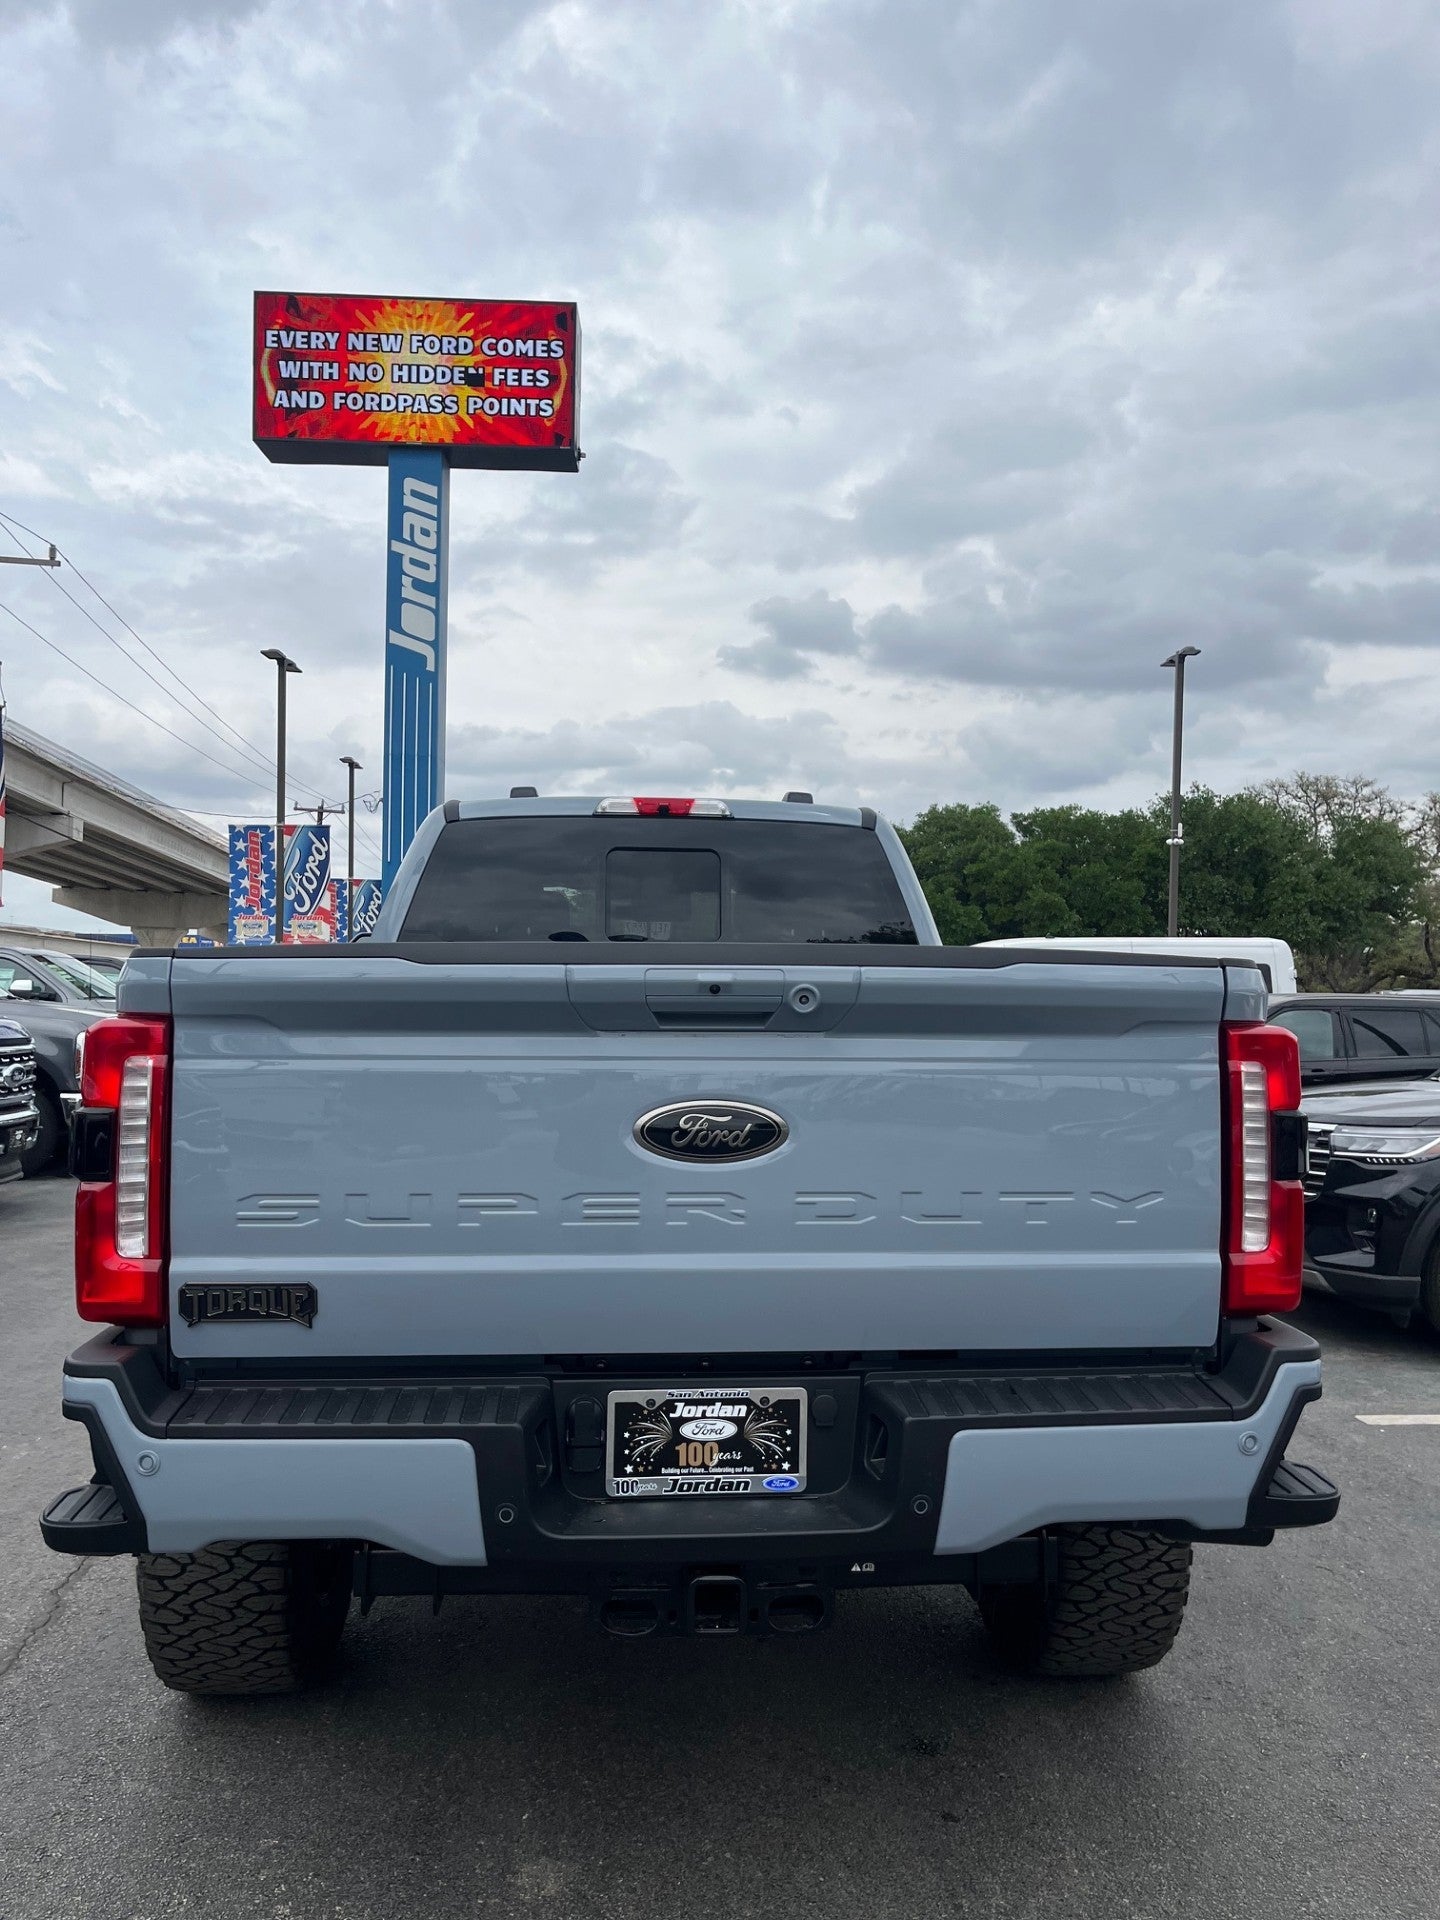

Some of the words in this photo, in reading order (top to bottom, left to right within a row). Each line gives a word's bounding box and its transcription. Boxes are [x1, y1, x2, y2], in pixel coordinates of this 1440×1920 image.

[265, 330, 340, 350] EVERY
[347, 333, 403, 352] NEW
[410, 335, 474, 355] FORD
[481, 338, 564, 358] COMES
[278, 360, 339, 381] WITH
[348, 362, 384, 382] NO
[493, 368, 550, 388] FEES
[273, 390, 325, 410] AND
[332, 391, 459, 414] FORDPASS
[467, 396, 554, 418] POINTS
[389, 477, 438, 672] Jordan
[244, 830, 263, 912] Jordan
[284, 831, 329, 913] Ford
[238, 913, 269, 921] Jordan
[292, 913, 324, 921] Jordan
[353, 883, 382, 935] Ford
[670, 1112, 753, 1148] Ford
[236, 1191, 746, 1227] SUPER
[794, 1190, 1164, 1225] DUTY
[182, 1284, 314, 1329] TORQUE
[666, 1390, 692, 1400] San
[694, 1389, 750, 1399] Antonio
[669, 1402, 747, 1418] Jordan
[691, 1422, 726, 1437] Ford
[675, 1441, 719, 1467] 100
[711, 1451, 742, 1466] years
[661, 1467, 680, 1475] Building
[708, 1466, 734, 1474] Celebrating
[613, 1479, 640, 1495] 100
[662, 1476, 751, 1495] Jordan
[770, 1479, 791, 1488] Ford
